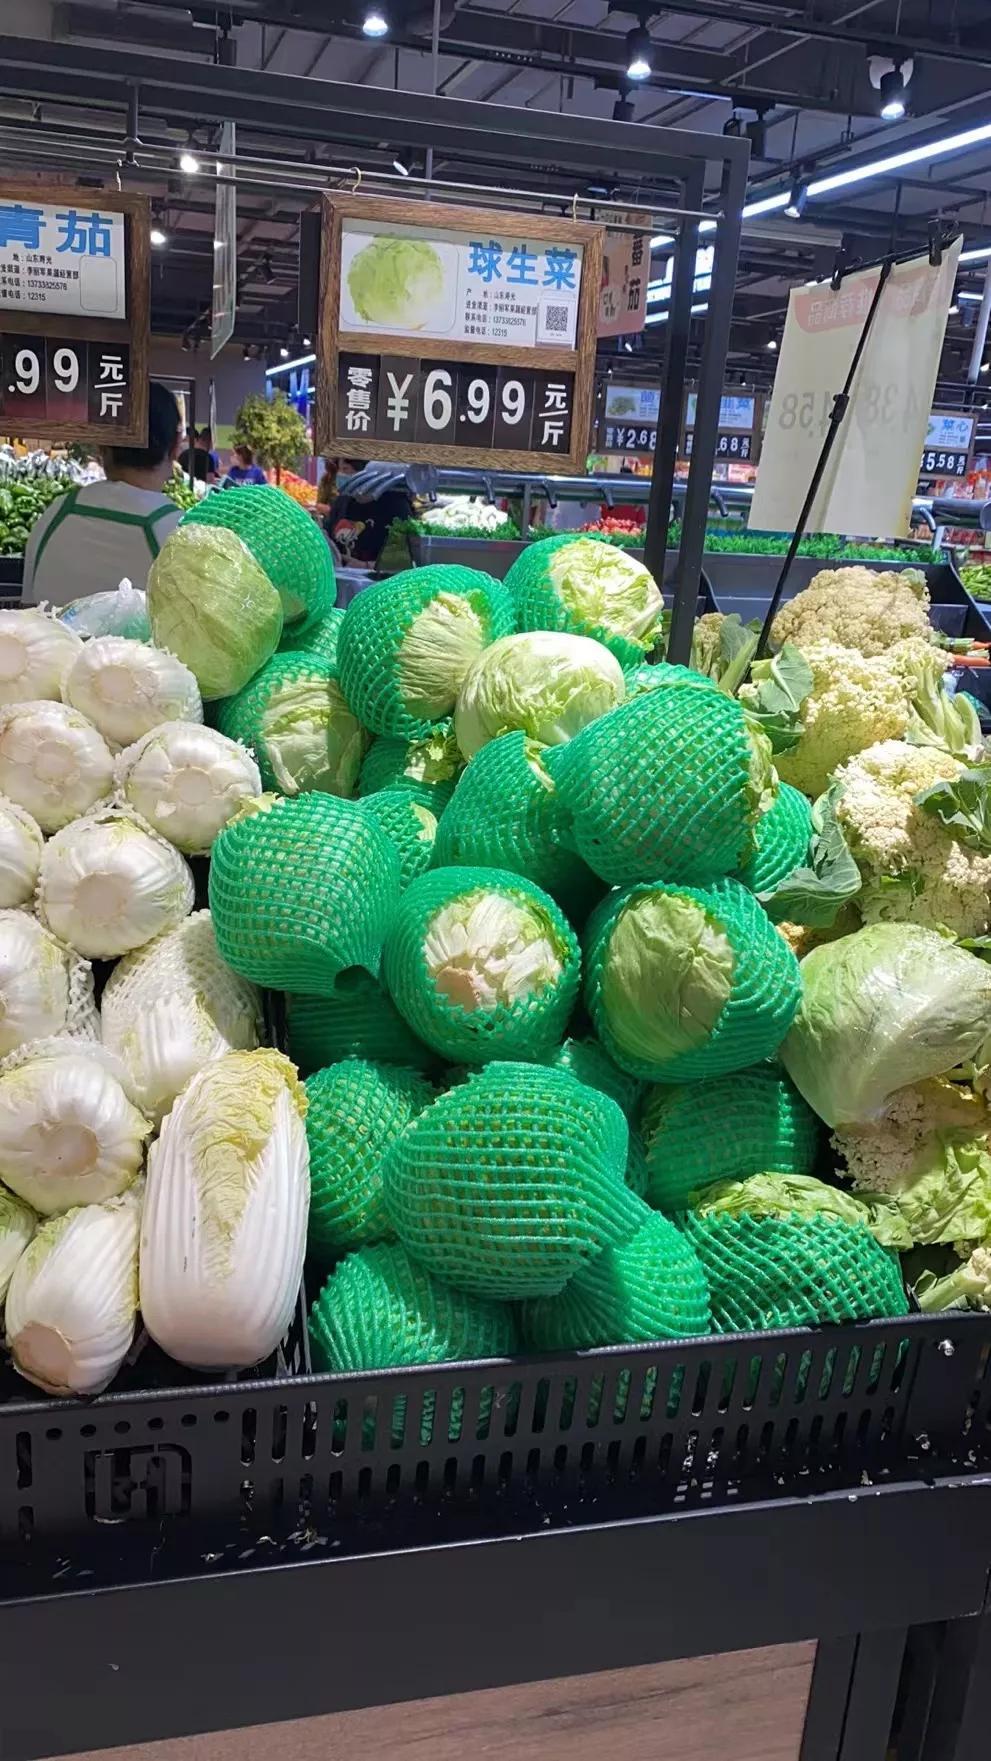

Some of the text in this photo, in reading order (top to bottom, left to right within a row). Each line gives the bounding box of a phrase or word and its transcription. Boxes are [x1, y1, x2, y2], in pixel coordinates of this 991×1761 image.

[468, 240, 578, 289] 球生菜
[94, 355, 127, 417] 元/斤
[346, 366, 373, 432] 零售价
[539, 383, 568, 446] 元/斤
